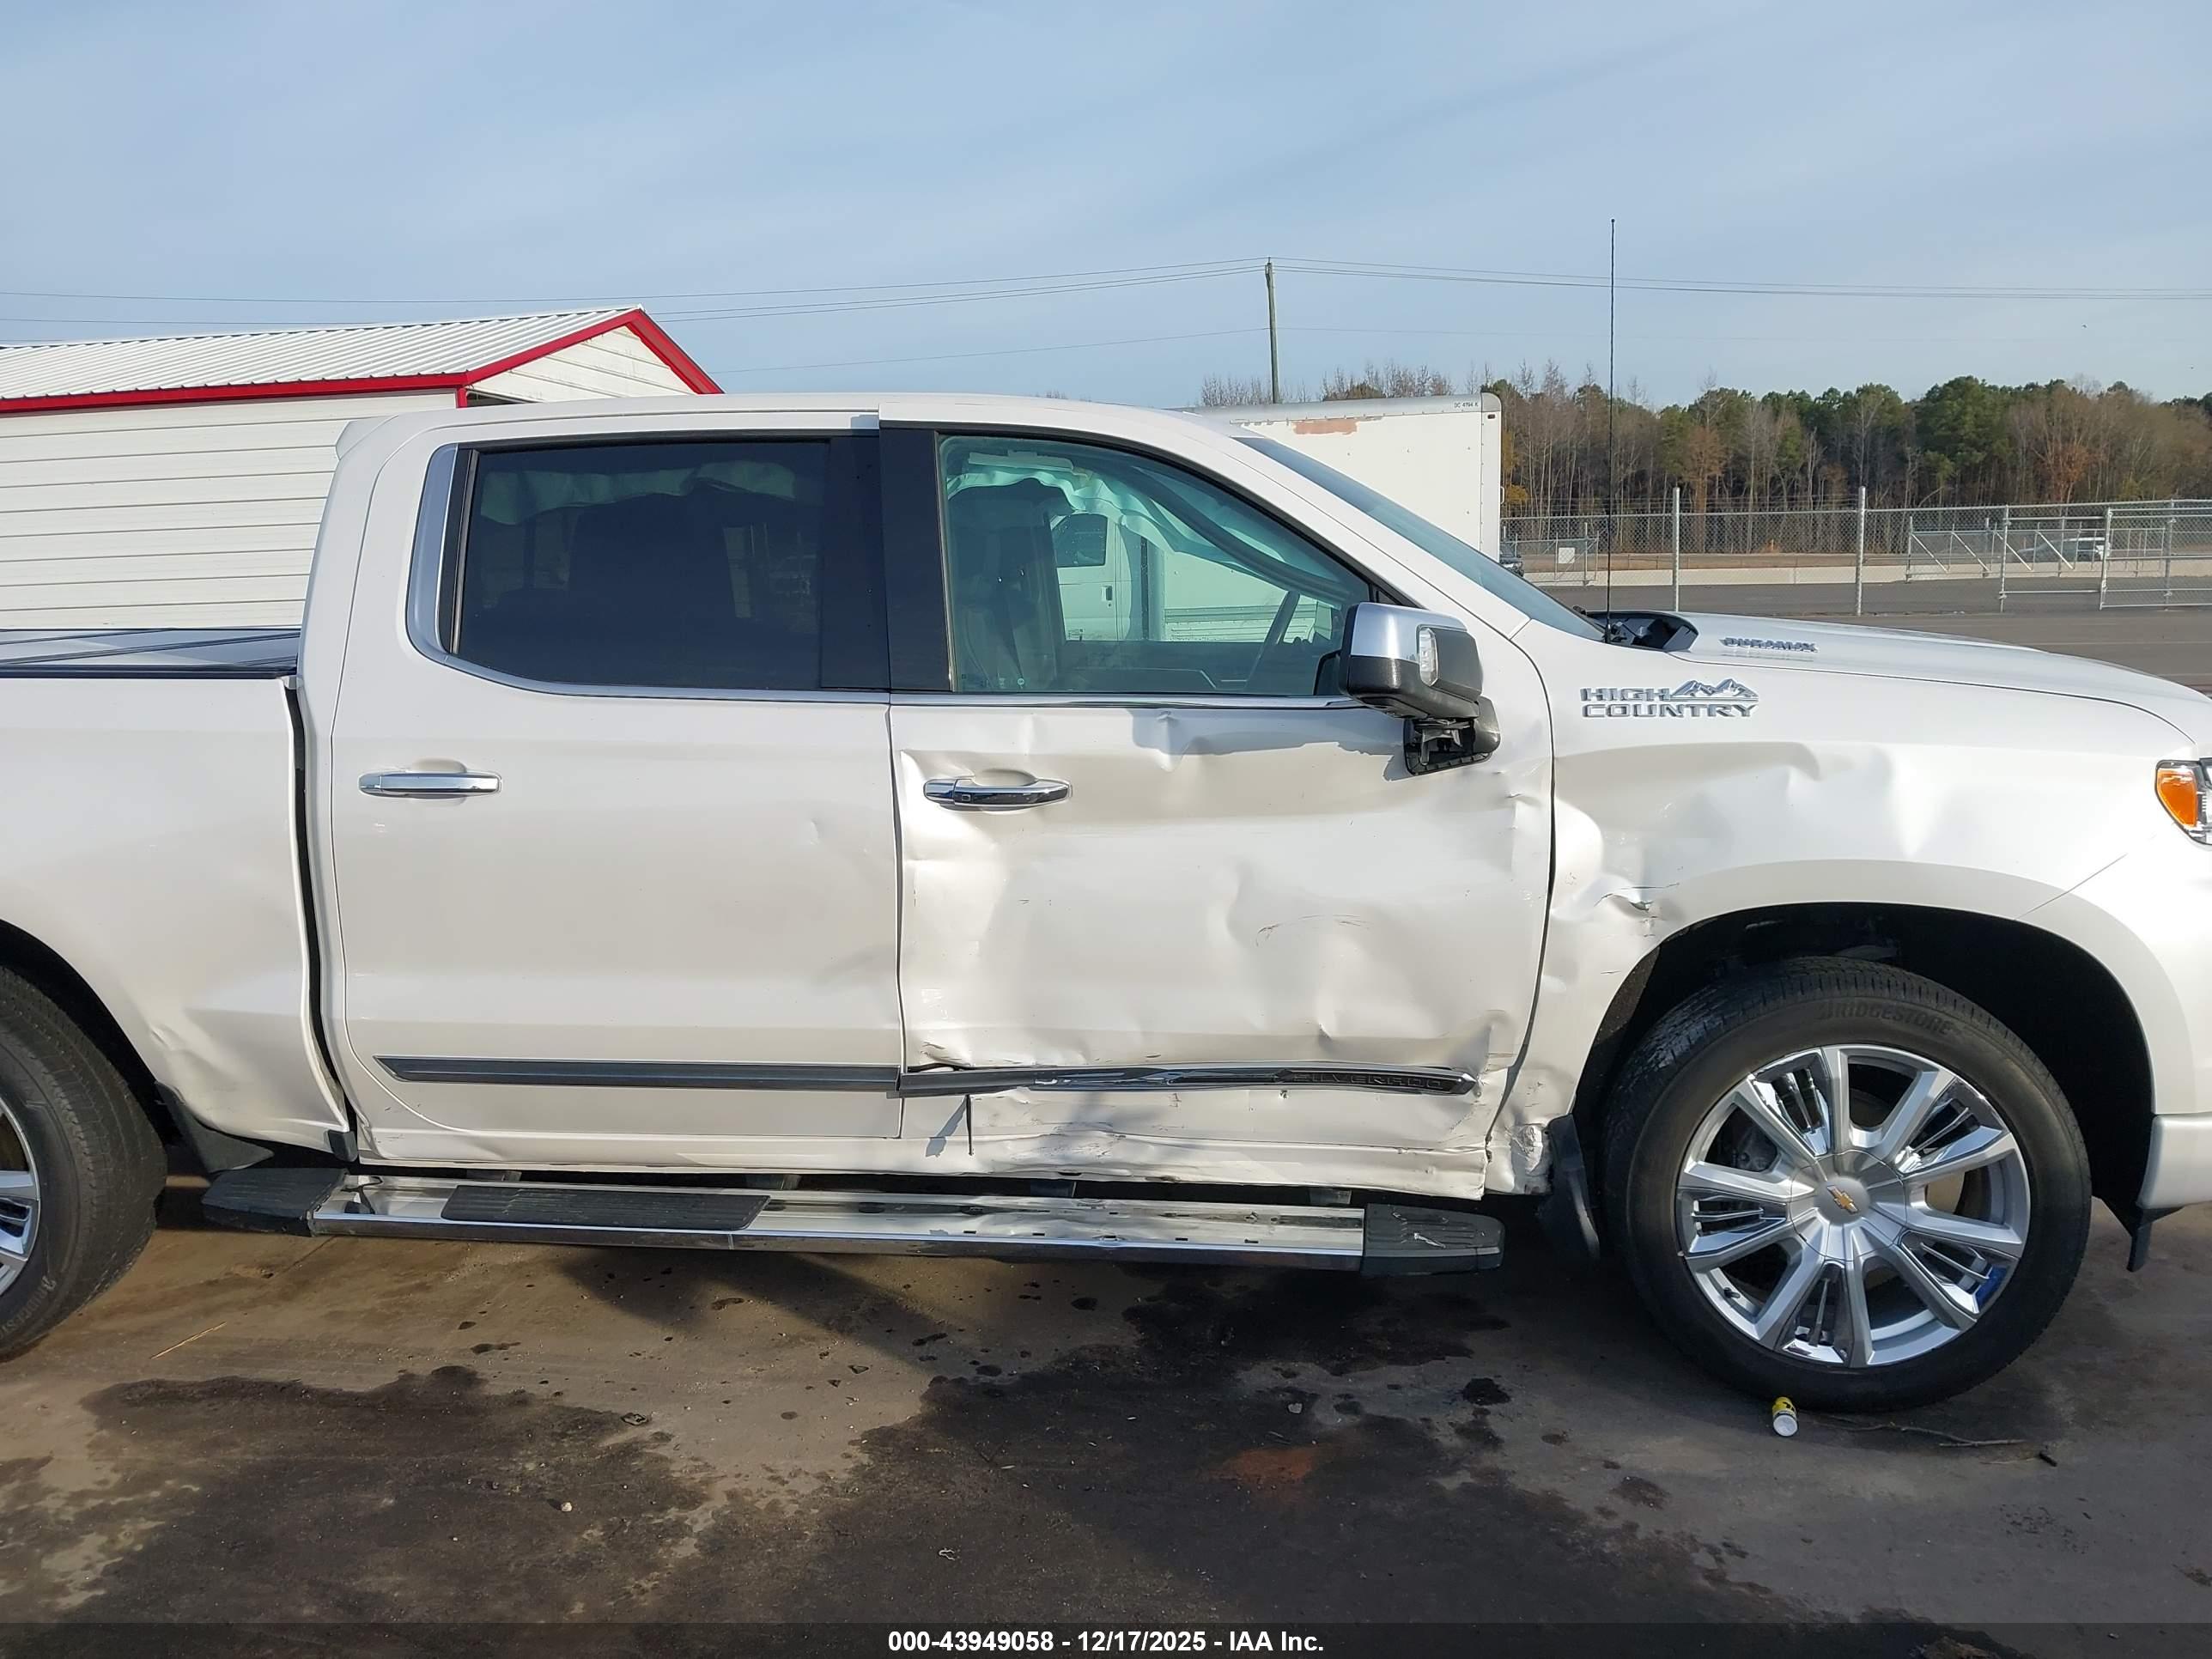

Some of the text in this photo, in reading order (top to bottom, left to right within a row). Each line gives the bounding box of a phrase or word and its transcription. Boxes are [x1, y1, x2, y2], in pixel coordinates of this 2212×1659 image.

[1720, 637, 1819, 652] DURAMAX
[1580, 687, 1675, 702] HIGH
[1582, 703, 1758, 718] COUNTRY
[1293, 1072, 1442, 1088] SILVERADO
